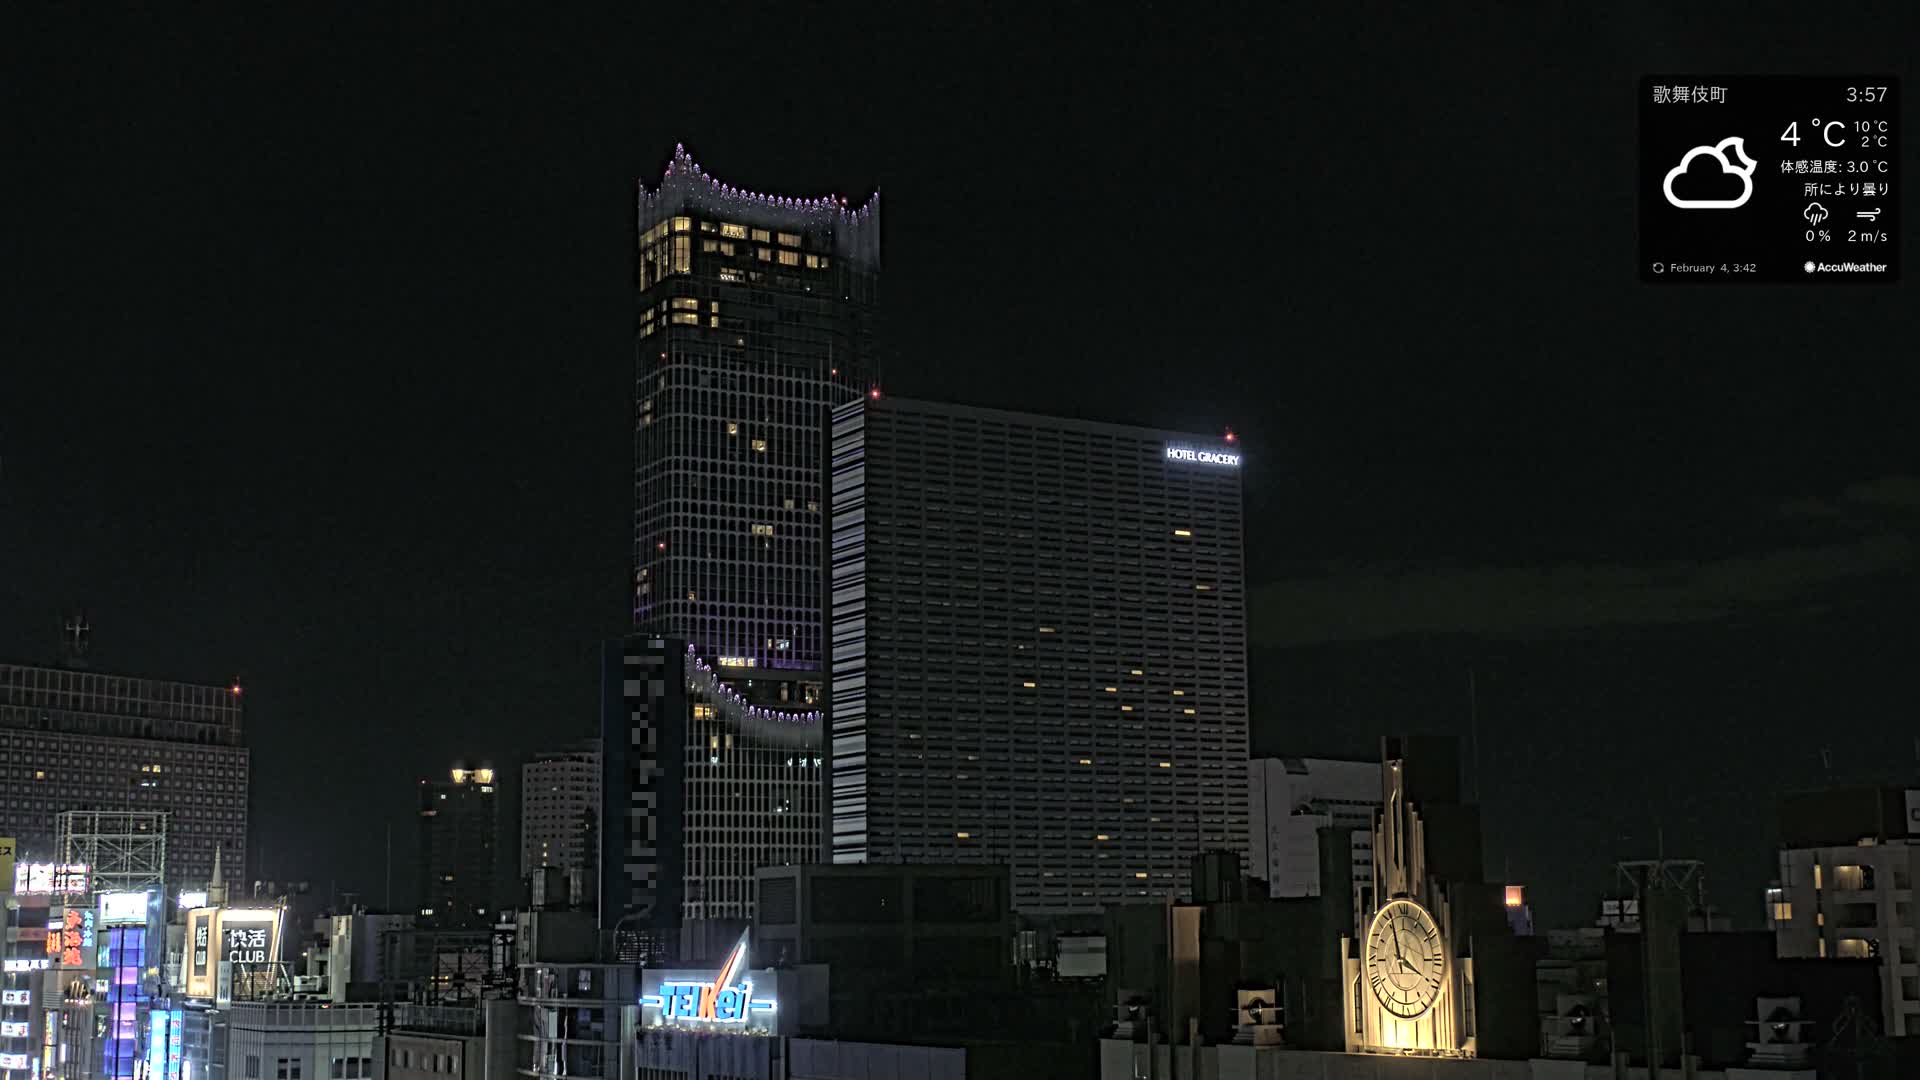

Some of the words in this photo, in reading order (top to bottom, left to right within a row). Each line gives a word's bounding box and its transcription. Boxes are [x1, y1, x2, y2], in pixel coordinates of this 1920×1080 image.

[1167, 448, 1197, 461] HOTEL
[1198, 452, 1239, 465] GRACERY
[230, 929, 266, 948] 快活
[229, 950, 265, 963] CLUB
